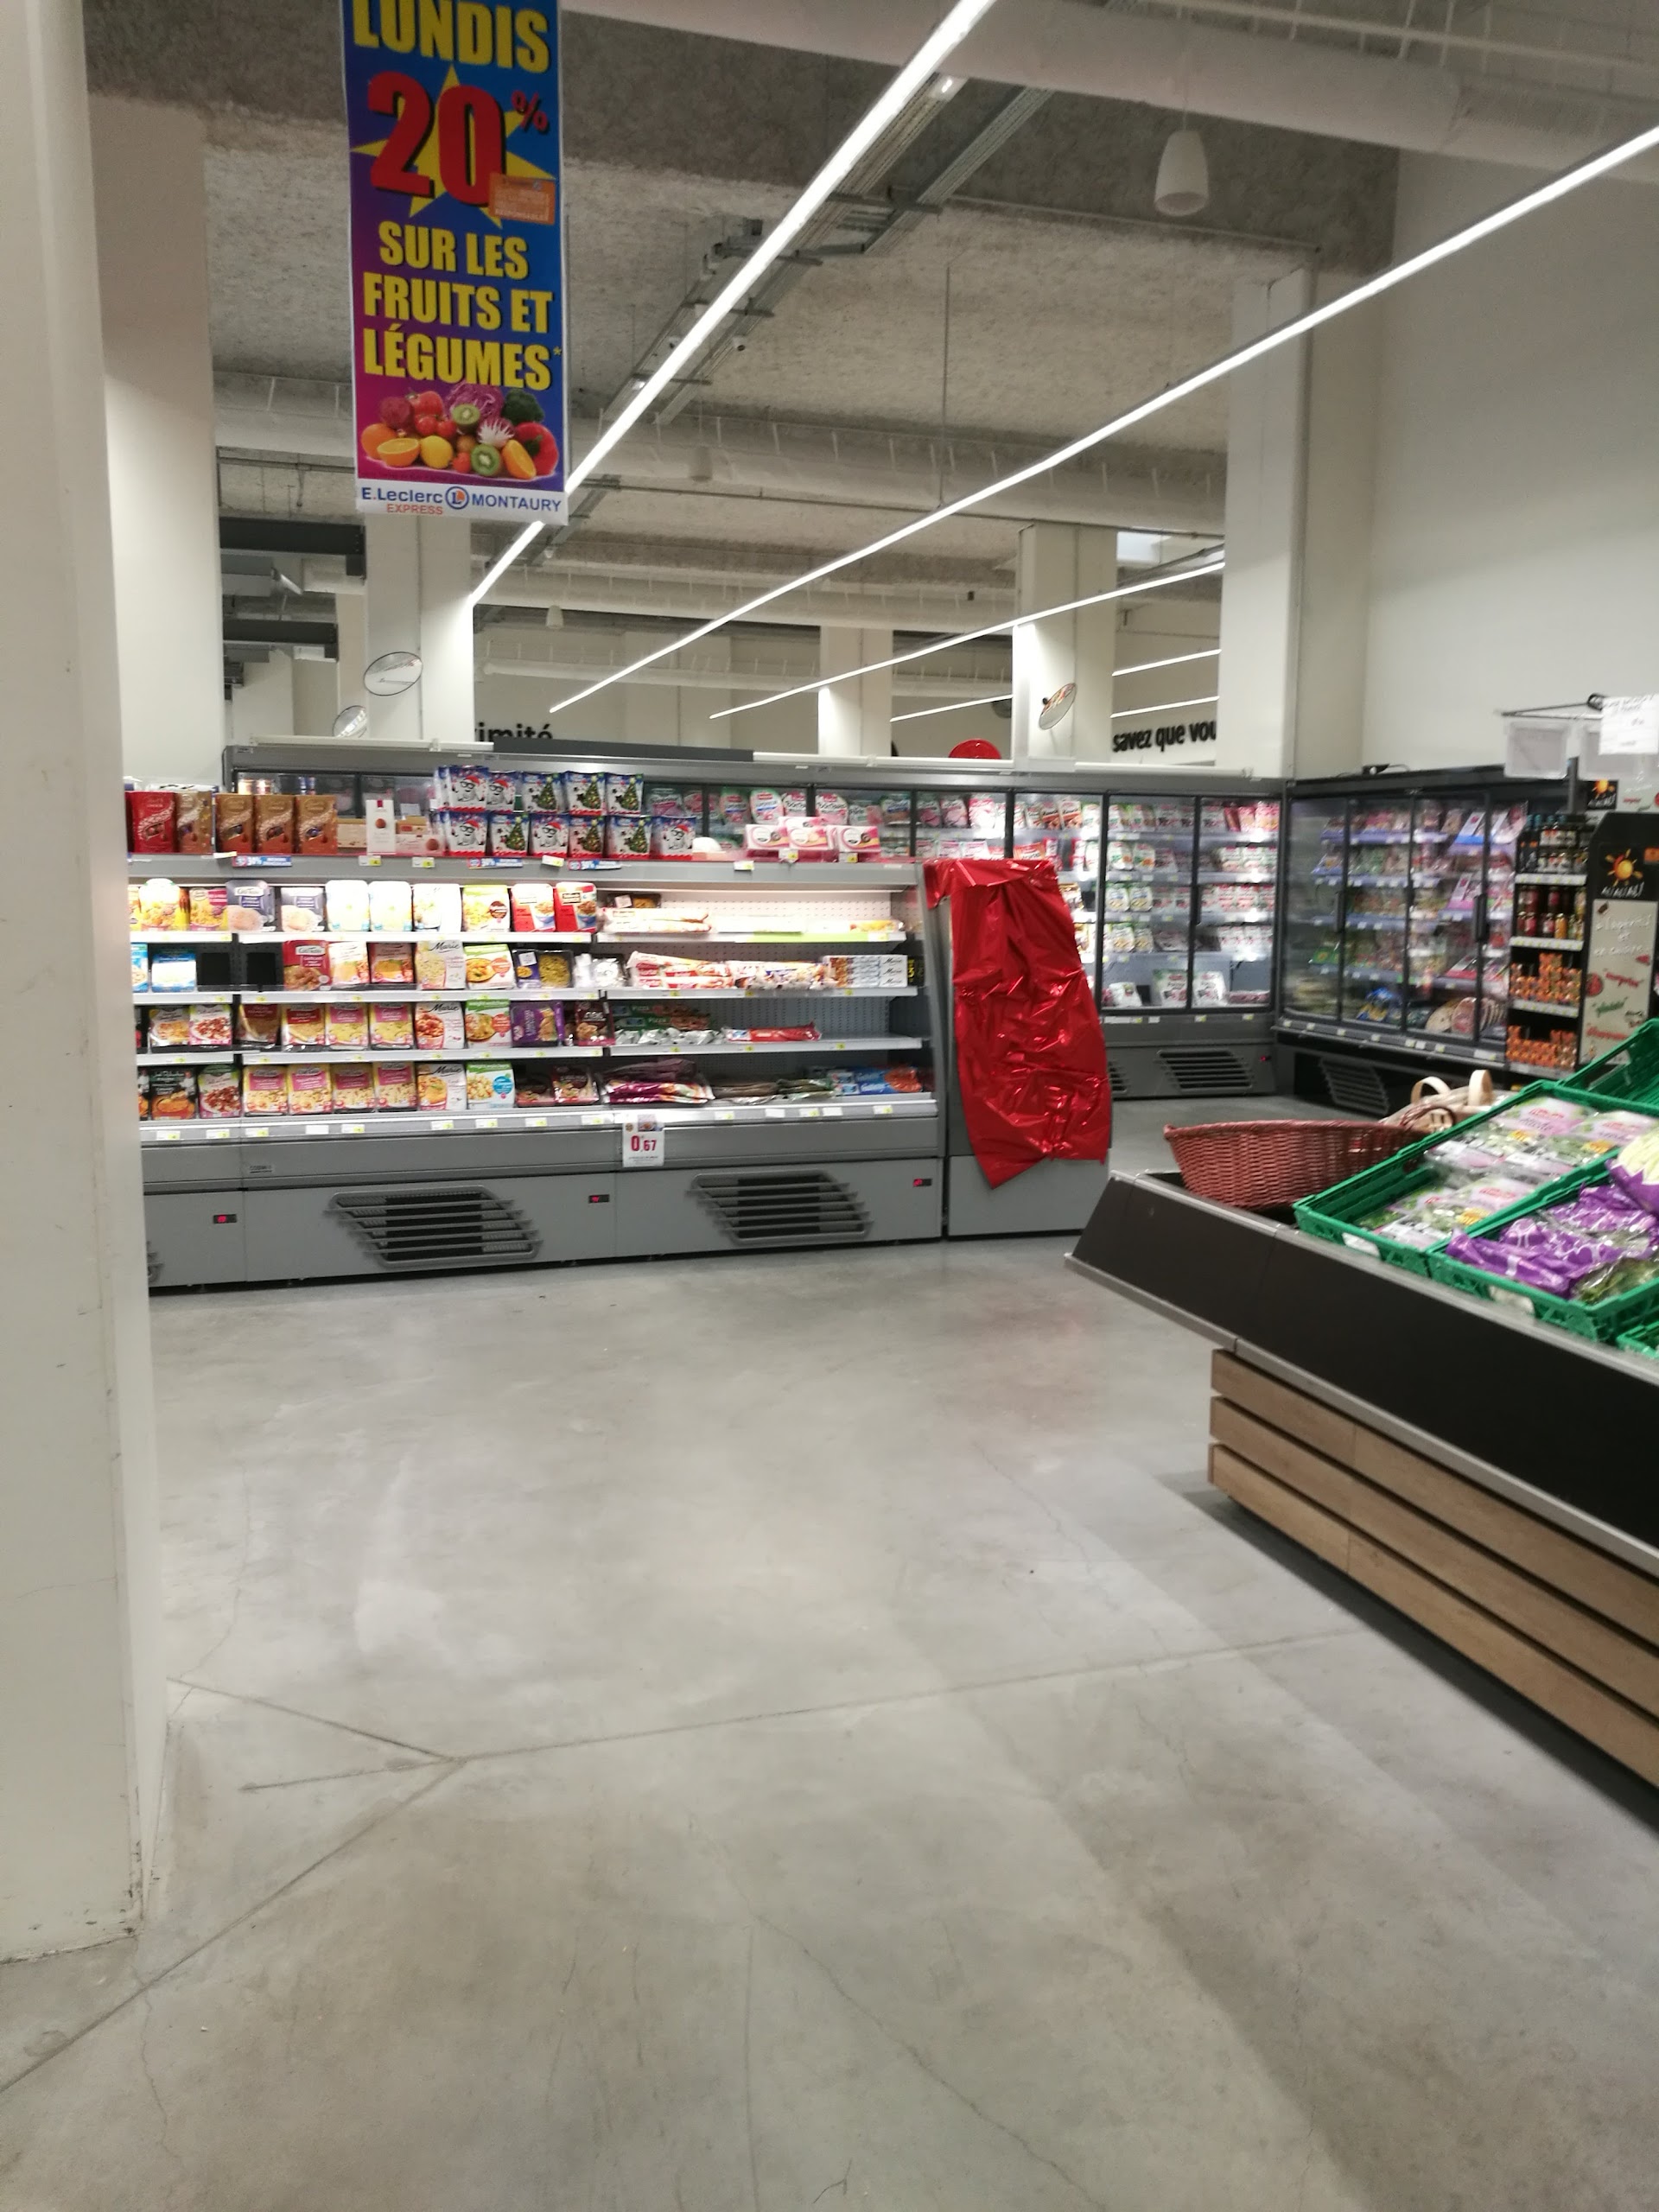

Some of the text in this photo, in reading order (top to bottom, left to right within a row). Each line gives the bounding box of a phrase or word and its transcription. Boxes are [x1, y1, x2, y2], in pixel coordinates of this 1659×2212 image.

[352, 0, 550, 73] LUNDIS
[378, 219, 530, 281] SUR LES
[363, 270, 554, 334] FRUITS ET
[386, 503, 443, 516] EXPRESS
[471, 493, 562, 512] MONTAURY
[1112, 728, 1153, 753] savez
[1155, 724, 1185, 752] que
[430, 941, 461, 952] Marie
[430, 1003, 460, 1012] Marie
[433, 1065, 463, 1074] Marie
